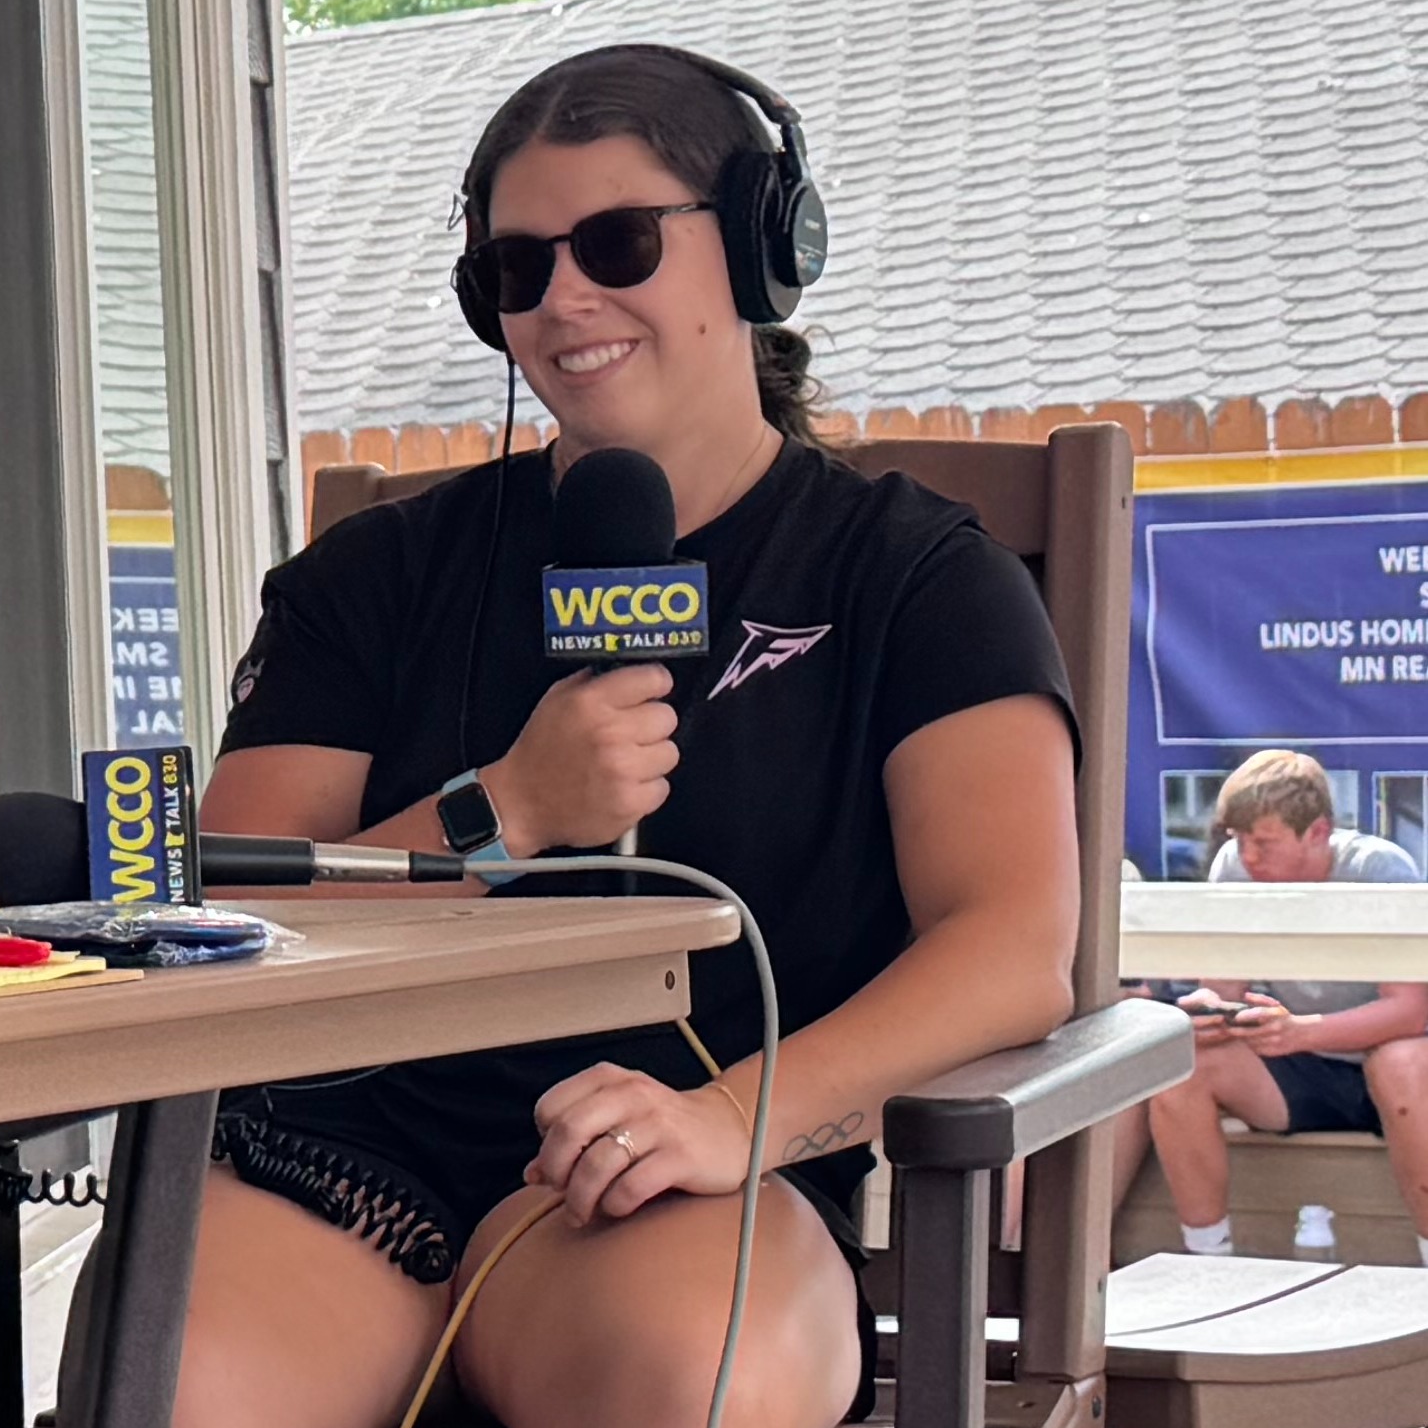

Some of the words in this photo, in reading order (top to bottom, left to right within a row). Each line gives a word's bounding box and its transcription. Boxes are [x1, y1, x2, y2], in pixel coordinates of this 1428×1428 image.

[549, 582, 700, 627] WCCO
[551, 635, 602, 651] NEWS
[623, 632, 666, 648] TALK
[667, 630, 703, 646] 830
[1260, 621, 1354, 648] LINDUS
[1361, 619, 1428, 645] HOM
[1341, 657, 1385, 682] MN
[162, 754, 178, 784] 830
[163, 787, 181, 829] TALK
[105, 756, 156, 904] WCCO
[166, 848, 185, 903] NEWS
